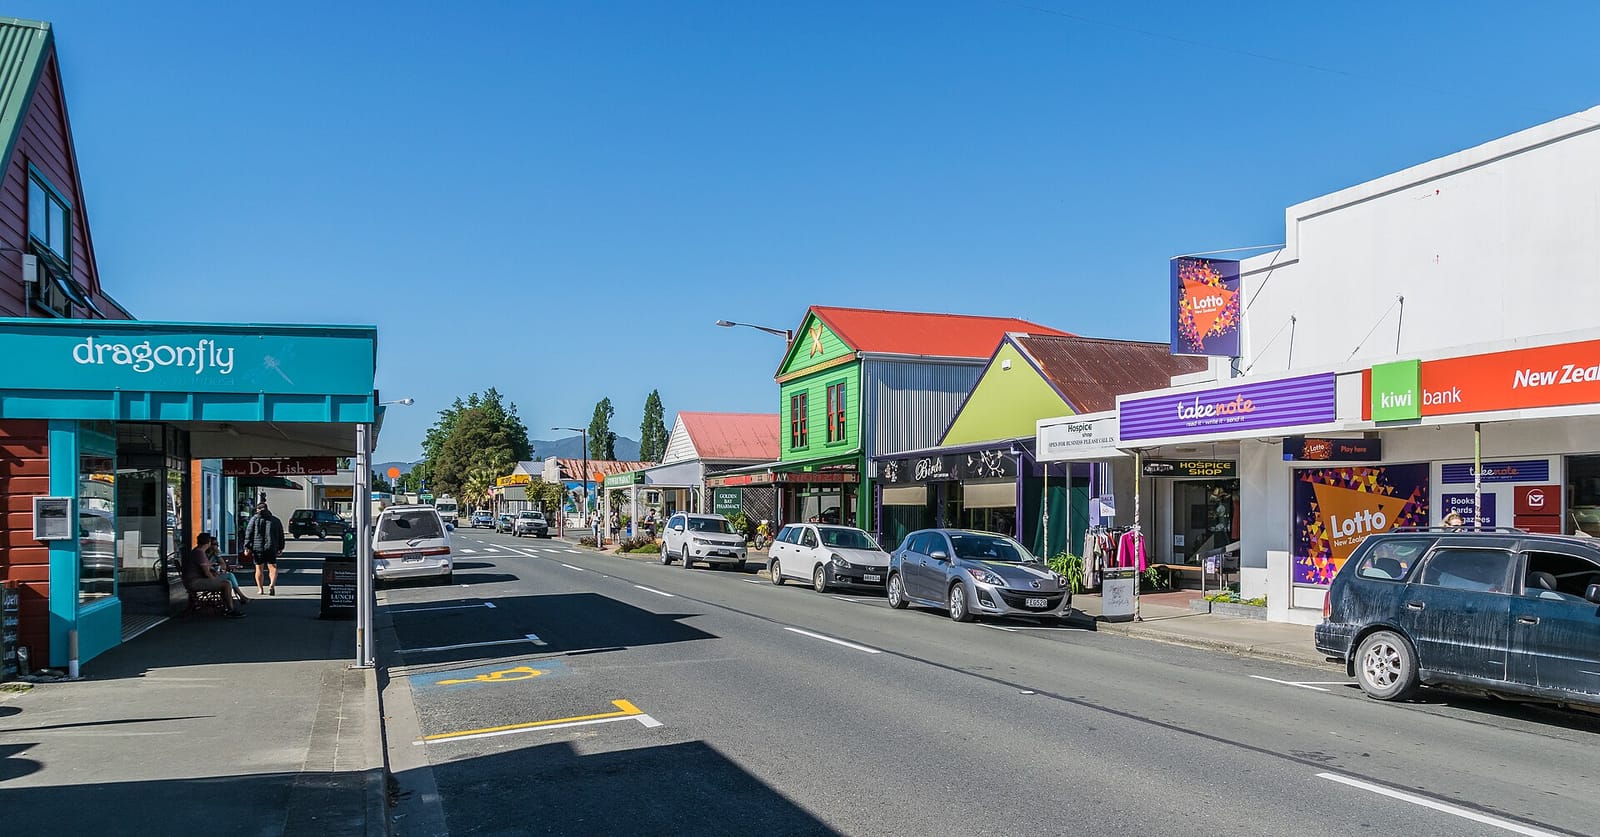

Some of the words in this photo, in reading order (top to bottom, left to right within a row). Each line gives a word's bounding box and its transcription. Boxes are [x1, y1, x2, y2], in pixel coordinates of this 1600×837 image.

[1192, 295, 1224, 310] Lotto
[72, 336, 235, 374] dragonfly
[1512, 368, 1559, 389] New
[1381, 389, 1412, 408] kiwi
[1423, 386, 1462, 405] bank
[1067, 423, 1093, 433] Hospice
[1310, 444, 1325, 452] Lotto
[1354, 445, 1367, 453] here
[249, 460, 305, 475] De-Lish
[1469, 465, 1519, 476] tkenote
[1451, 497, 1475, 505] Books
[1451, 506, 1473, 514] Cards
[1330, 509, 1386, 539] Lotto
[1333, 539, 1347, 547] New
